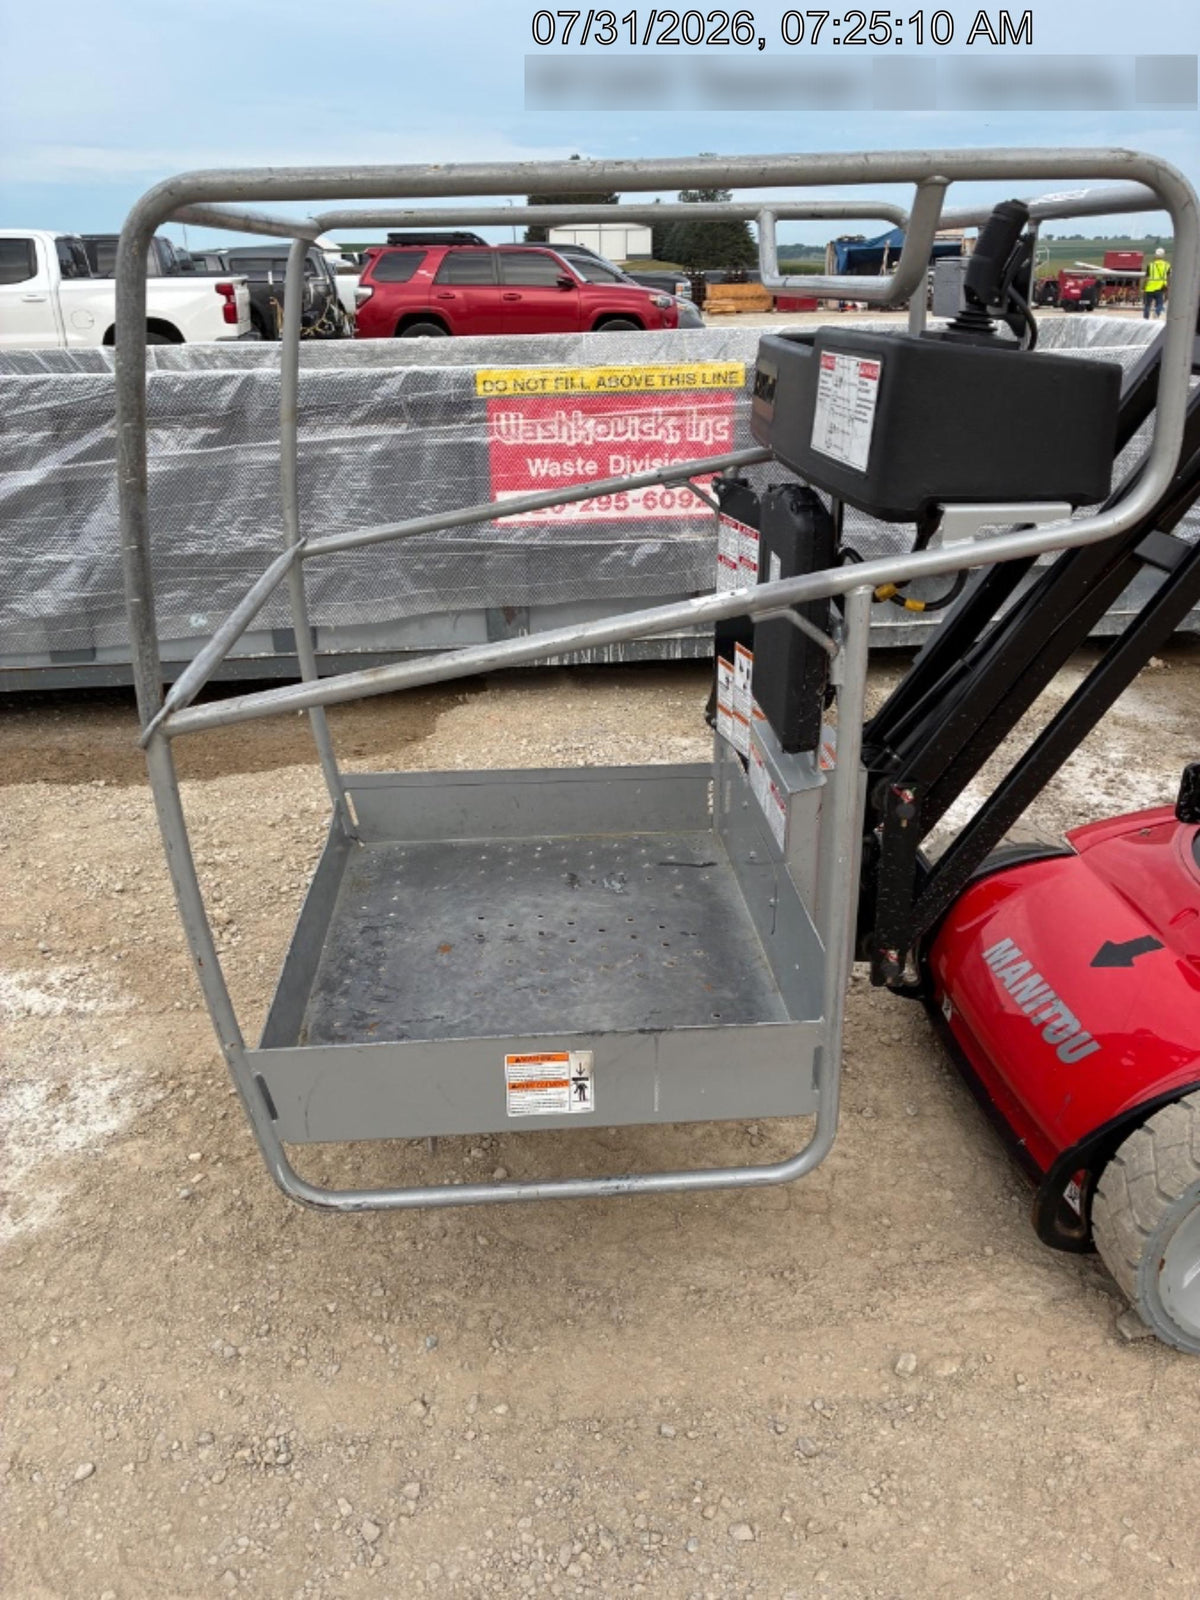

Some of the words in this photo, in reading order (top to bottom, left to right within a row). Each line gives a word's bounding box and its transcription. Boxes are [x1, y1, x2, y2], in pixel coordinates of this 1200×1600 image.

[482, 379, 508, 393] DO
[513, 378, 548, 392] NOT
[554, 376, 590, 391] FILL
[596, 374, 656, 389] ABOVE
[659, 373, 697, 387] THIS
[701, 370, 740, 385] LINE
[527, 458, 599, 478] Waste
[982, 938, 1102, 1065] MANITOU
